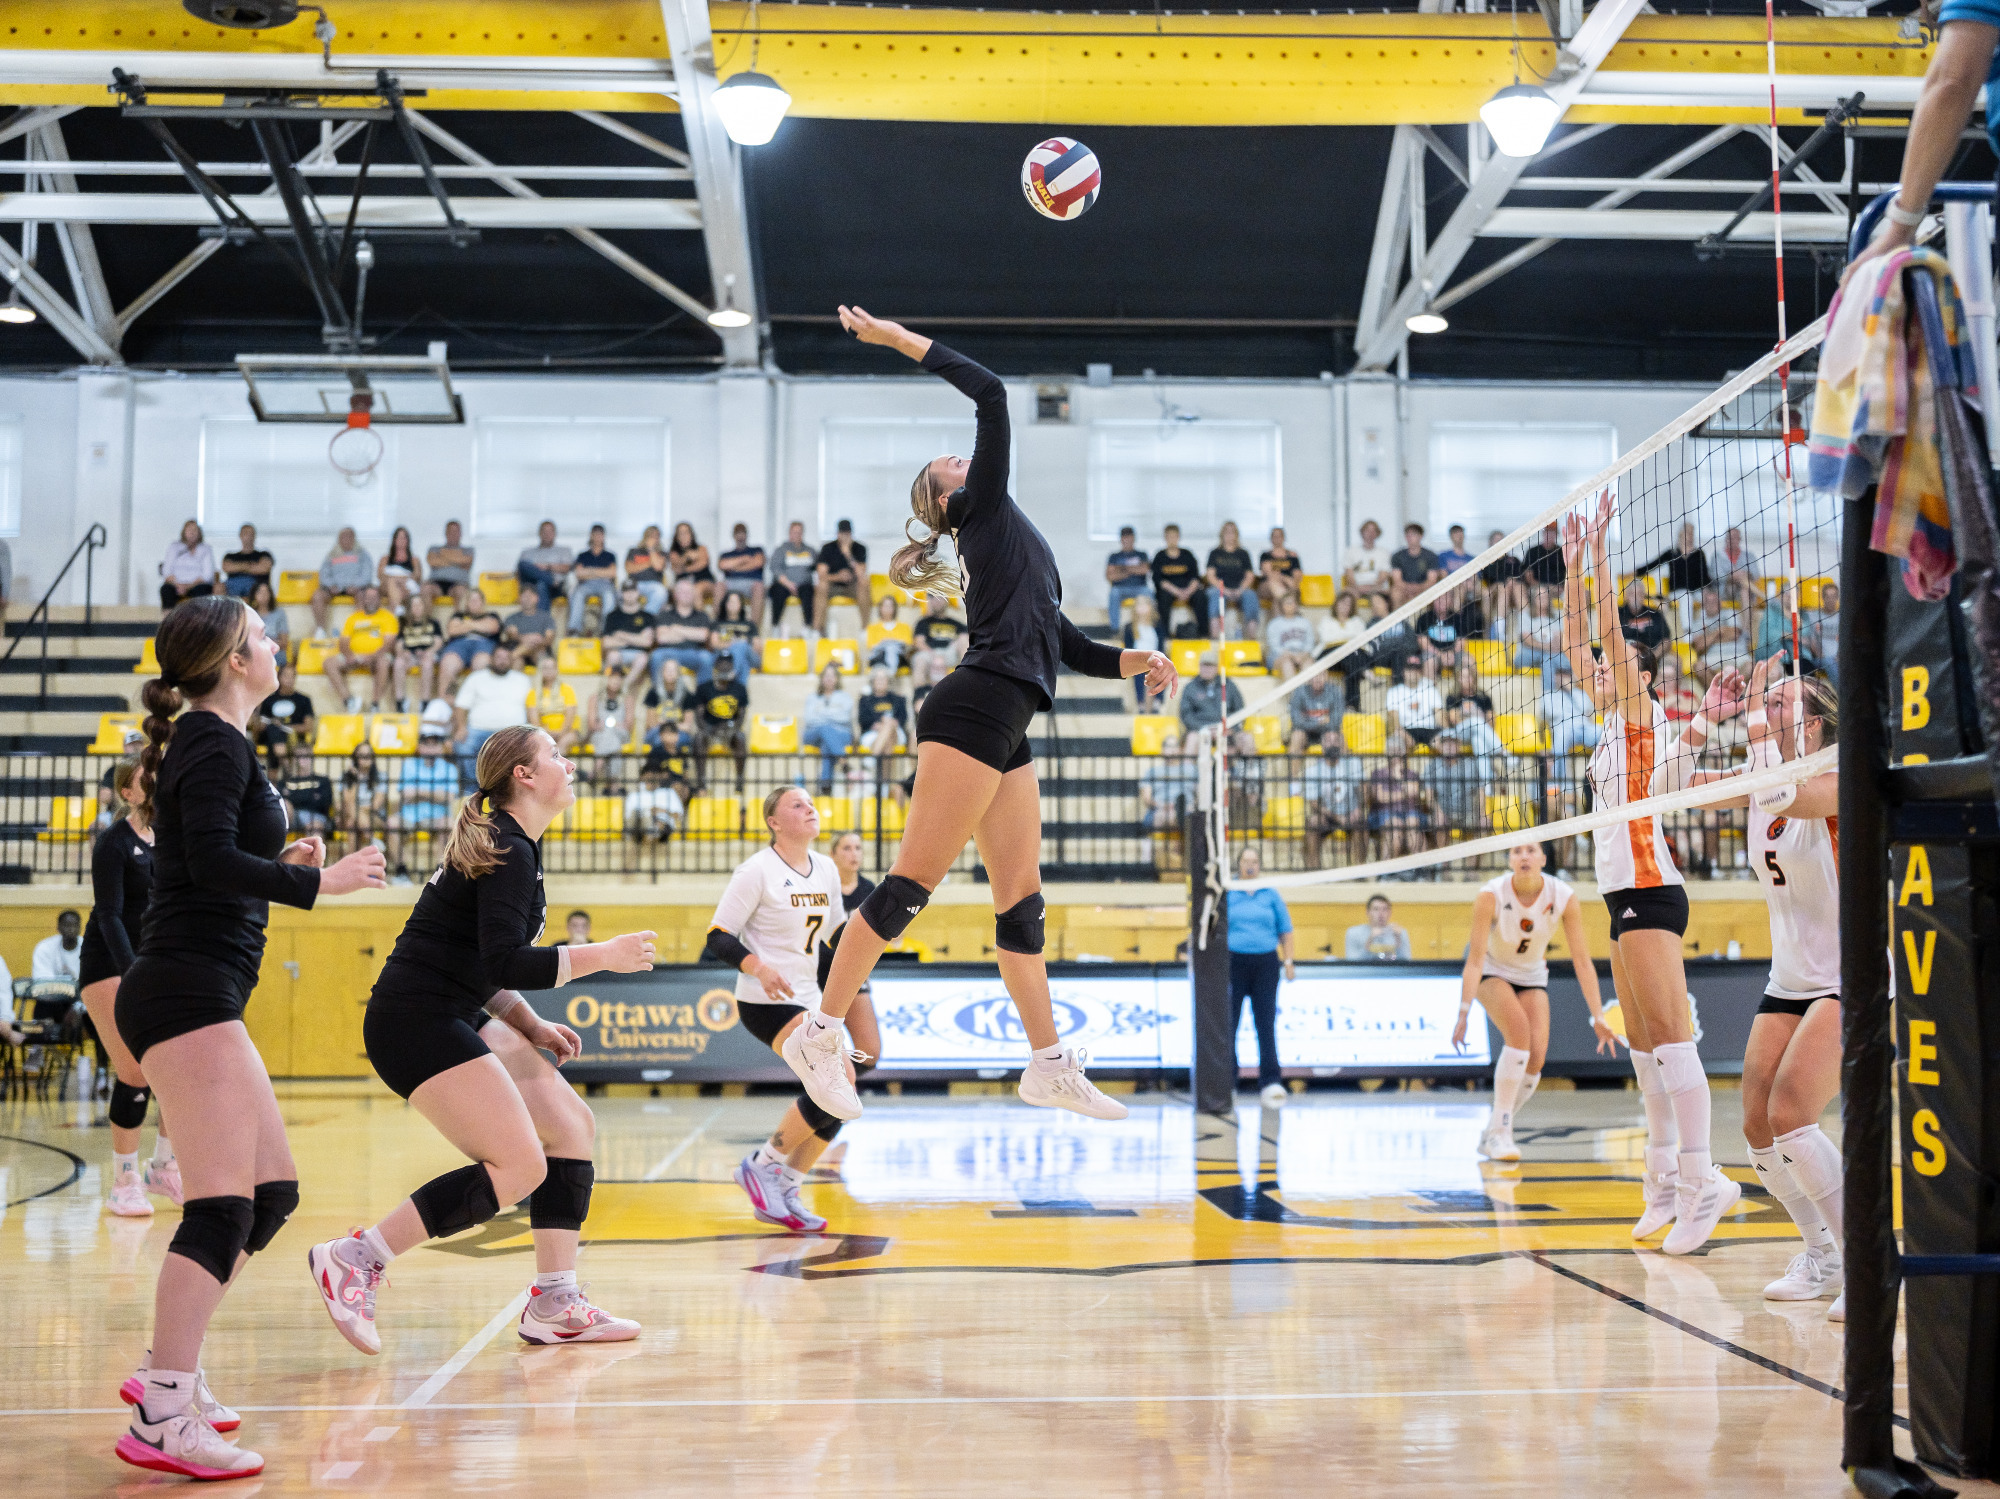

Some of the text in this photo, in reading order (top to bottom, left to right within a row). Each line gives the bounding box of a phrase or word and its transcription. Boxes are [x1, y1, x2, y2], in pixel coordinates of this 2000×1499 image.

[1033, 179, 1055, 209] NAIA
[1765, 850, 1786, 886] 5
[790, 893, 830, 908] OTTAW
[804, 914, 824, 955] 7
[1899, 665, 1947, 1177] BAVES
[1517, 938, 1531, 954] 6
[566, 995, 695, 1028] Ottawa
[1326, 1016, 1440, 1032] Bank
[599, 1027, 710, 1053] University
